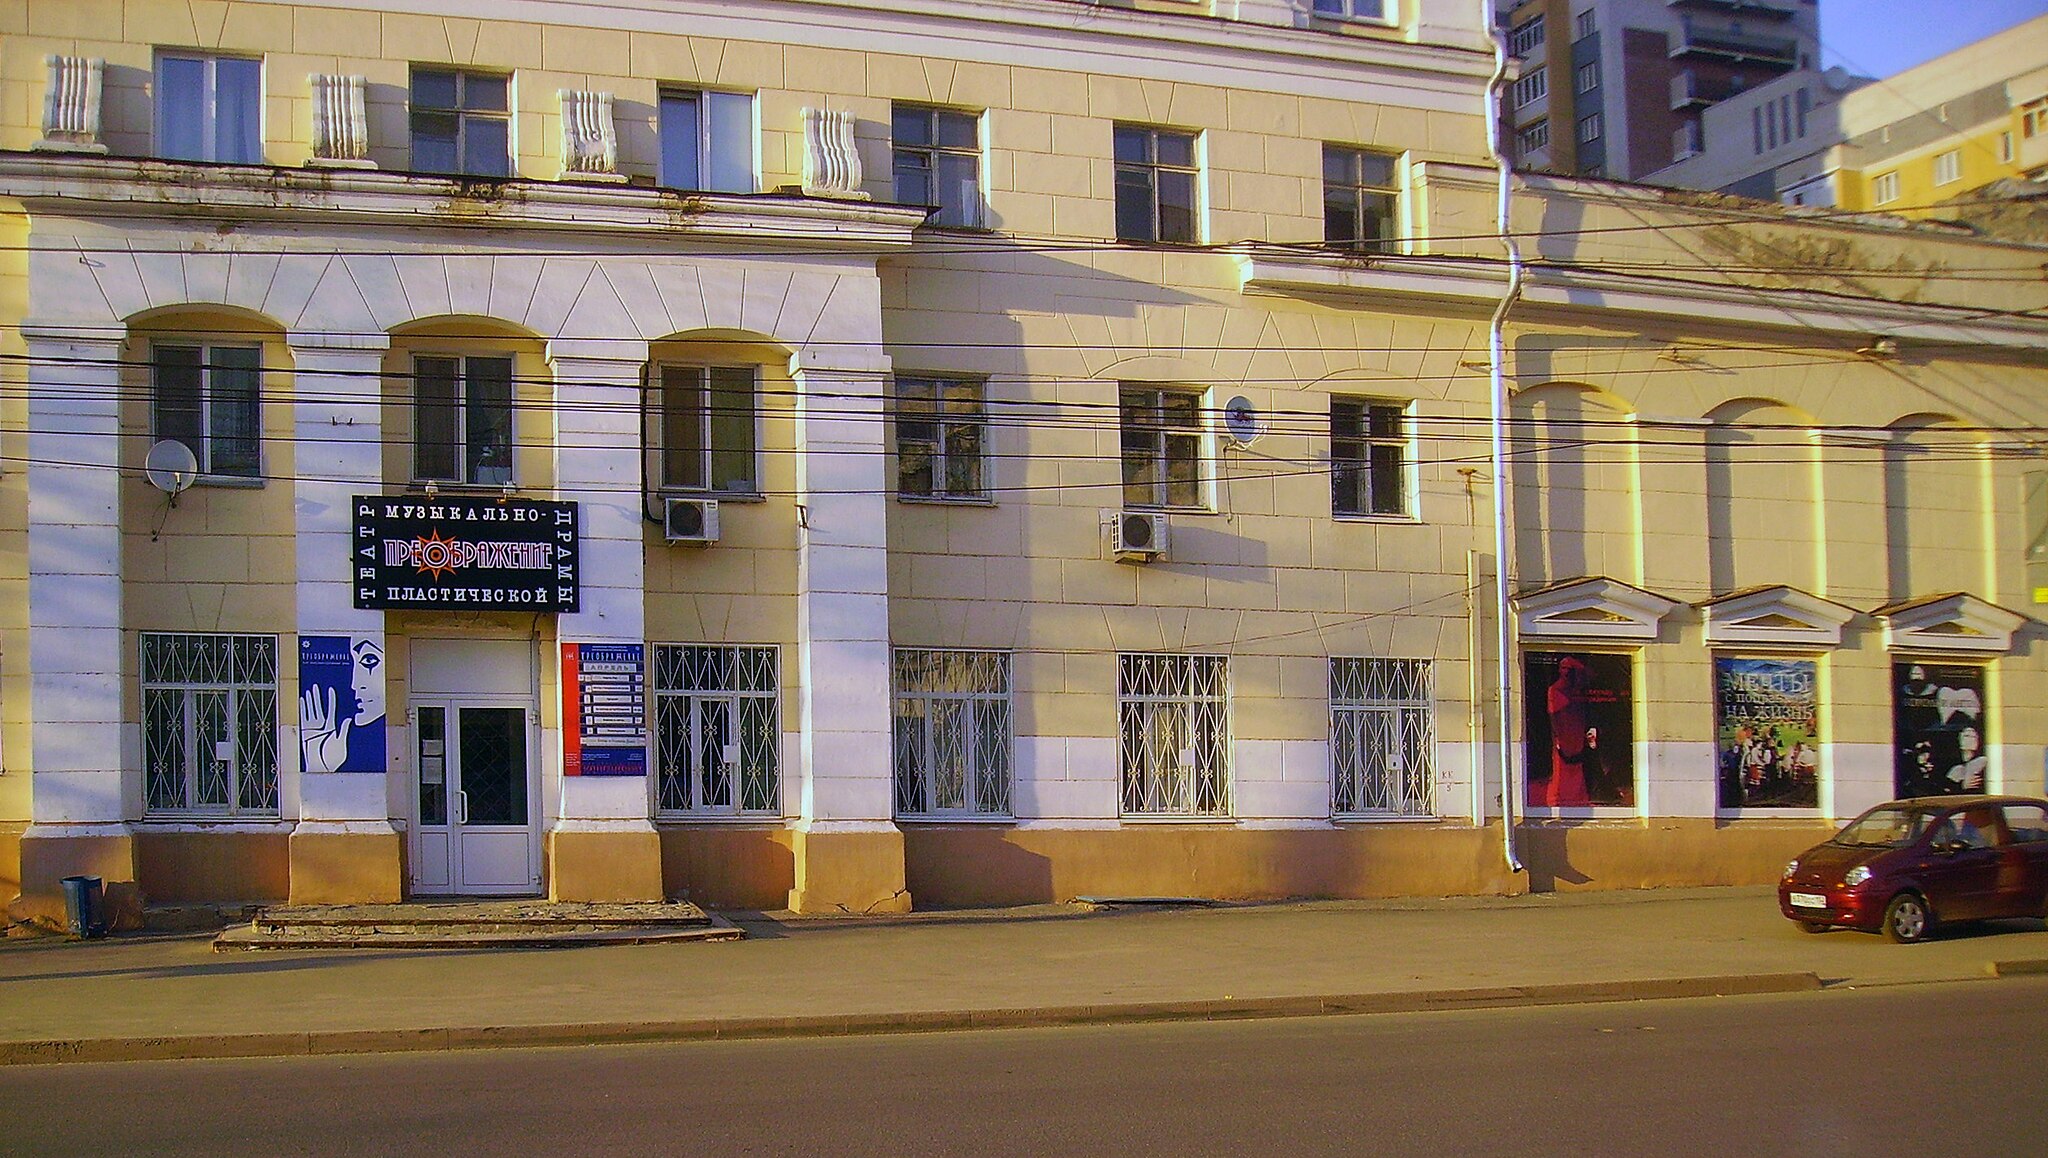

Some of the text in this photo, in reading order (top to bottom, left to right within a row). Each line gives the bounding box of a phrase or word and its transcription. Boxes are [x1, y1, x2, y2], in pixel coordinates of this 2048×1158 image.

[385, 505, 547, 522] МУЗЫКАЛЬНО-
[360, 505, 375, 599] ТЕАТР
[383, 538, 553, 569] ПРЕОБРАЖЕНИЕ
[554, 510, 573, 604] ДРАМЫ
[387, 586, 548, 602] ПЛАСТИЧЕСКОЙ
[1724, 673, 1809, 692] МЕЧТЫ
[1726, 705, 1813, 720] НА ЖИЗНЬ
